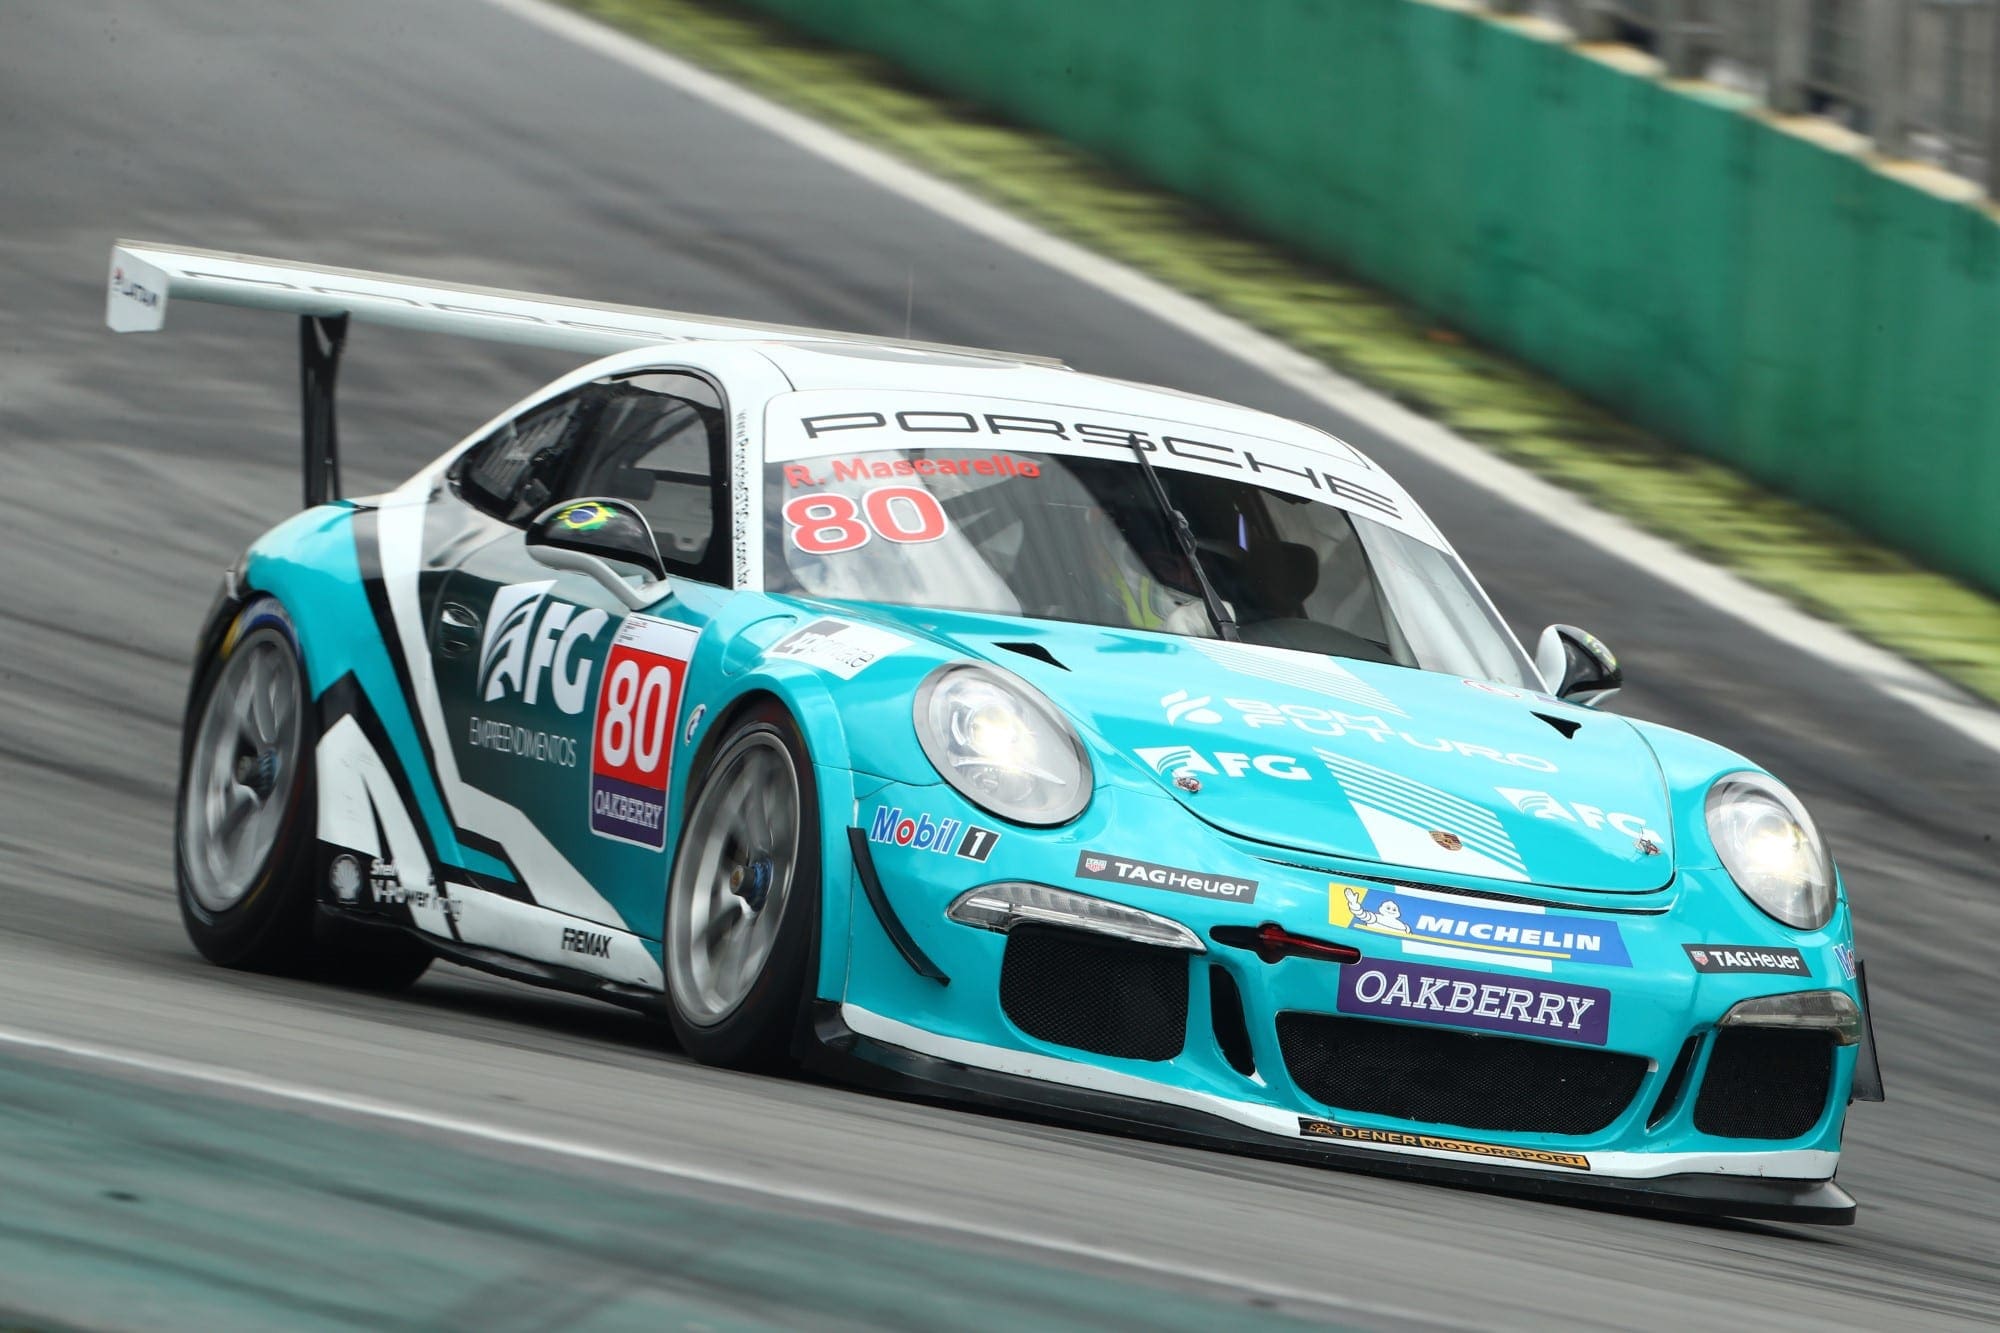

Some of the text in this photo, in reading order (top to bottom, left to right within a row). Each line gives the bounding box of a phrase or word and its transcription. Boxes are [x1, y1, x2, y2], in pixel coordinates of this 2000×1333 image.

[784, 455, 1042, 489] R. Mascarello
[801, 410, 1404, 521] PORSCHE
[781, 483, 952, 556] 80
[477, 579, 609, 714] AFG
[602, 659, 672, 774] 80
[1224, 696, 1396, 735] BOM
[469, 716, 577, 768] EMPREENDIMENTOS
[1243, 713, 1559, 773] FUTURO
[594, 788, 664, 830] OAKBERRY
[869, 805, 962, 854] Mobil
[561, 926, 613, 960] FREMAX
[1416, 914, 1601, 952] MICHELIN
[1354, 969, 1596, 1031] OAKBERRY
[1341, 1126, 1584, 1167] DENER MOTORSPORT
